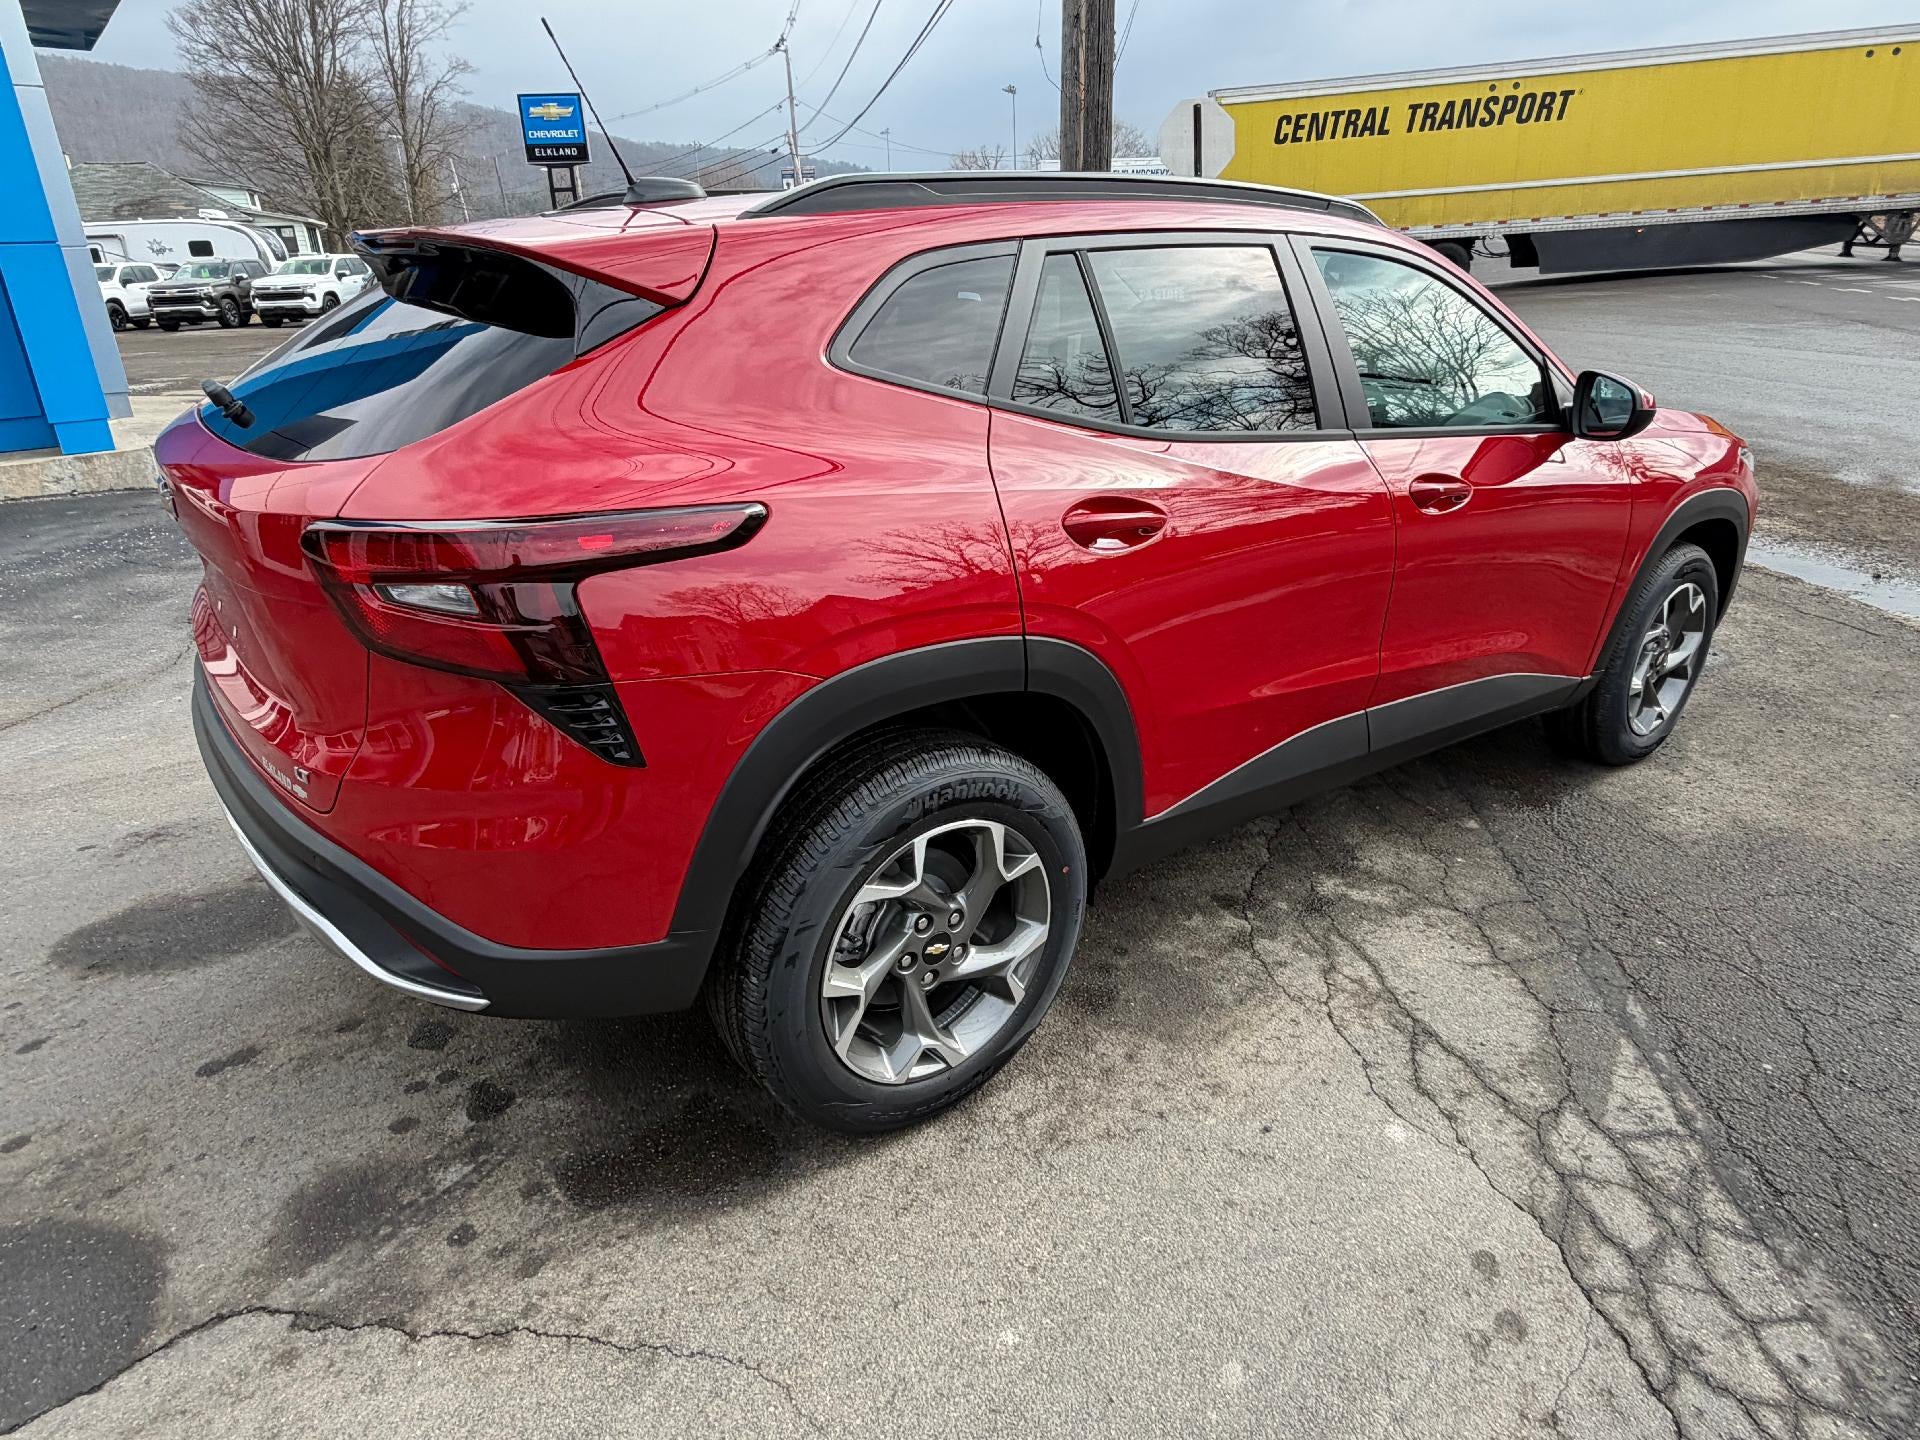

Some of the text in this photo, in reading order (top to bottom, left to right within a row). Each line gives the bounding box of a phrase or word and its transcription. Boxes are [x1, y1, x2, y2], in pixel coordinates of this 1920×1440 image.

[1273, 89, 1576, 145] CENTRAL TRANSPORT
[528, 129, 579, 138] CHEVROLET
[535, 147, 578, 156] ELKLAND
